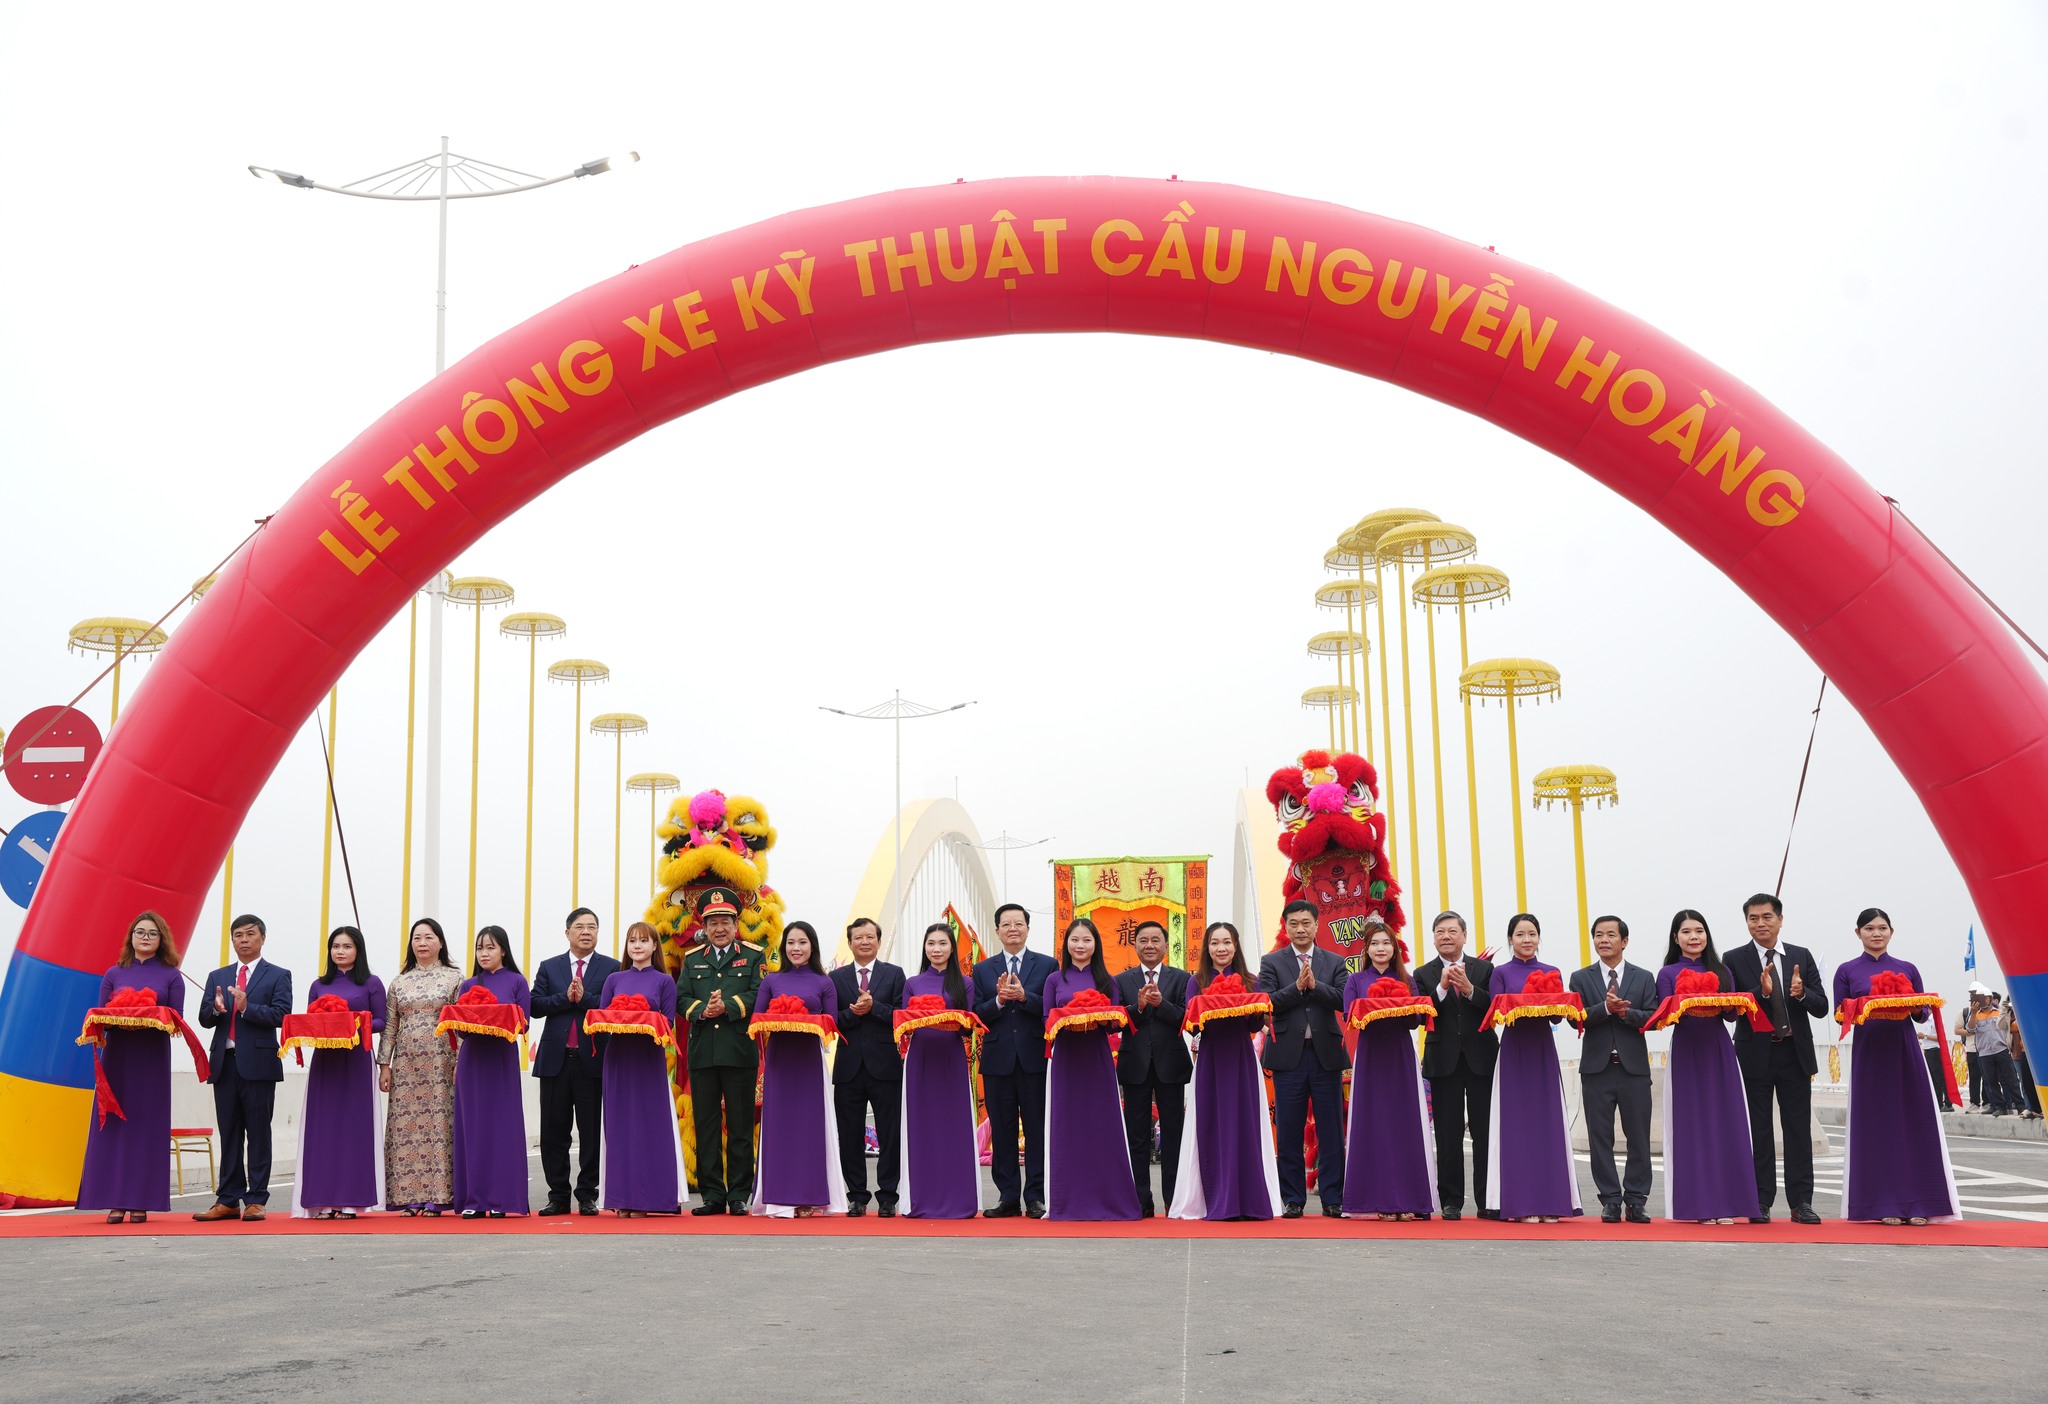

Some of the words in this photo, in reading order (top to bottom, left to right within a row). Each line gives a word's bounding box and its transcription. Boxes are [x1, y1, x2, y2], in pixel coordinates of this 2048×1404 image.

[318, 479, 401, 576] LỄ
[383, 340, 614, 510] THÔNG
[623, 290, 716, 371] XE
[732, 249, 817, 331] KỸ
[844, 208, 1067, 297] THUẬT
[1091, 199, 1247, 284] CẦU
[1265, 235, 1558, 371] NGUYỄN
[1555, 335, 1806, 527] HOÀNG
